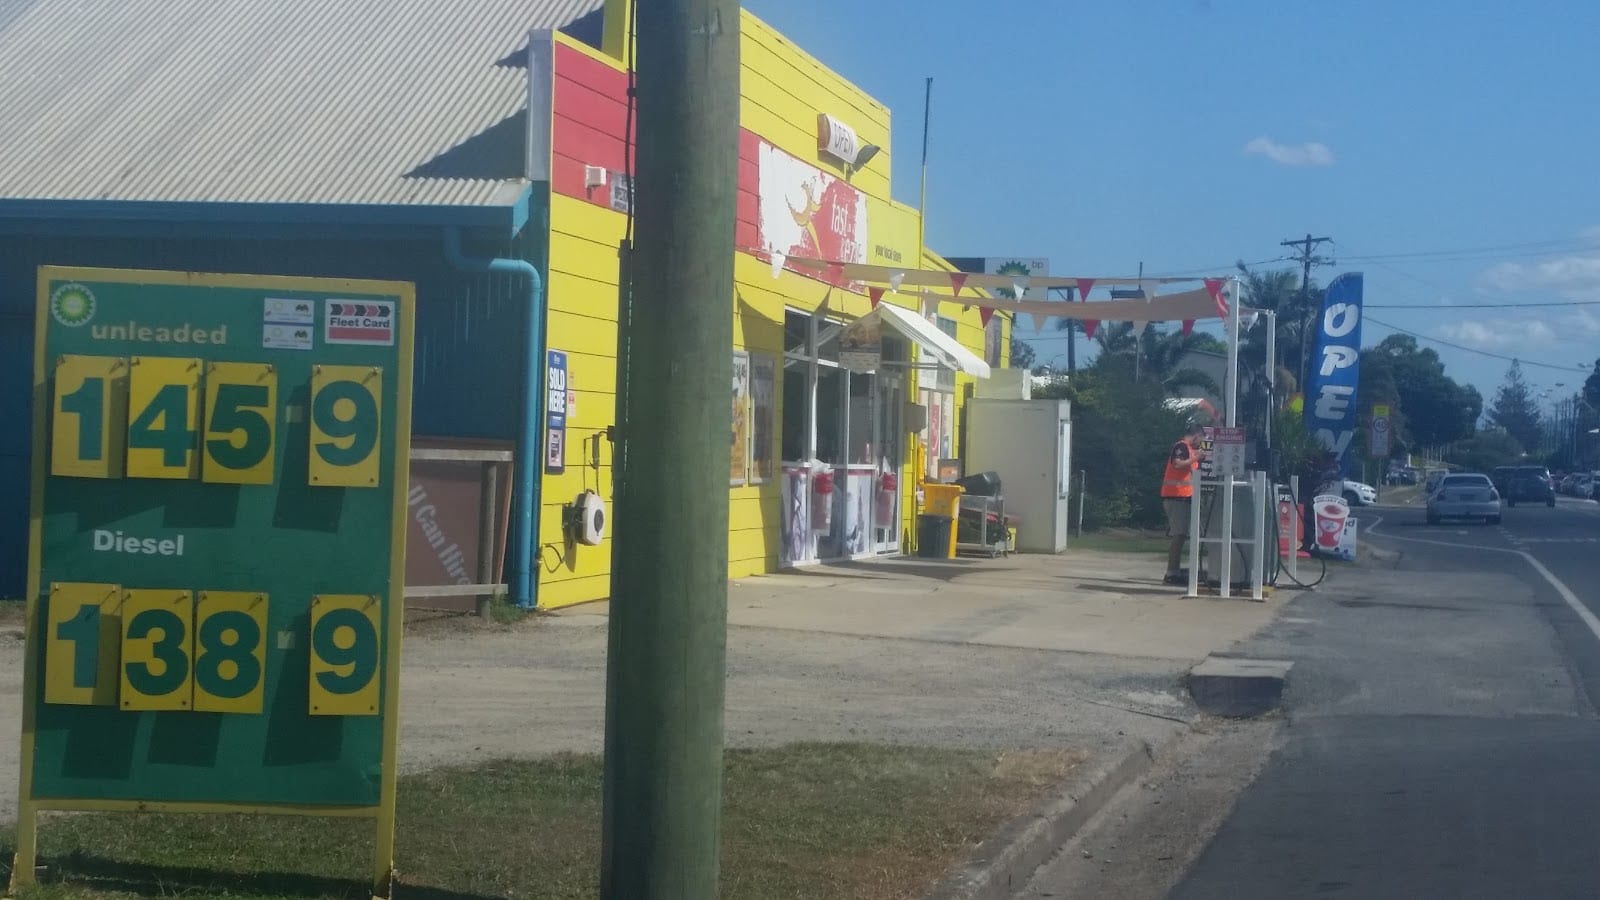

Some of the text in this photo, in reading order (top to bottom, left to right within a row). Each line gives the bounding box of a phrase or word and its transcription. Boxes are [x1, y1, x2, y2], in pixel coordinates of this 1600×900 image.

[1031, 260, 1044, 269] bp
[91, 320, 228, 345] unleaded
[329, 317, 390, 328] Fleet Card
[549, 367, 565, 391] SOLD
[1314, 302, 1359, 461] OPEN
[548, 389, 565, 413] HERE
[415, 504, 446, 549] Can
[93, 529, 185, 556] Diesel
